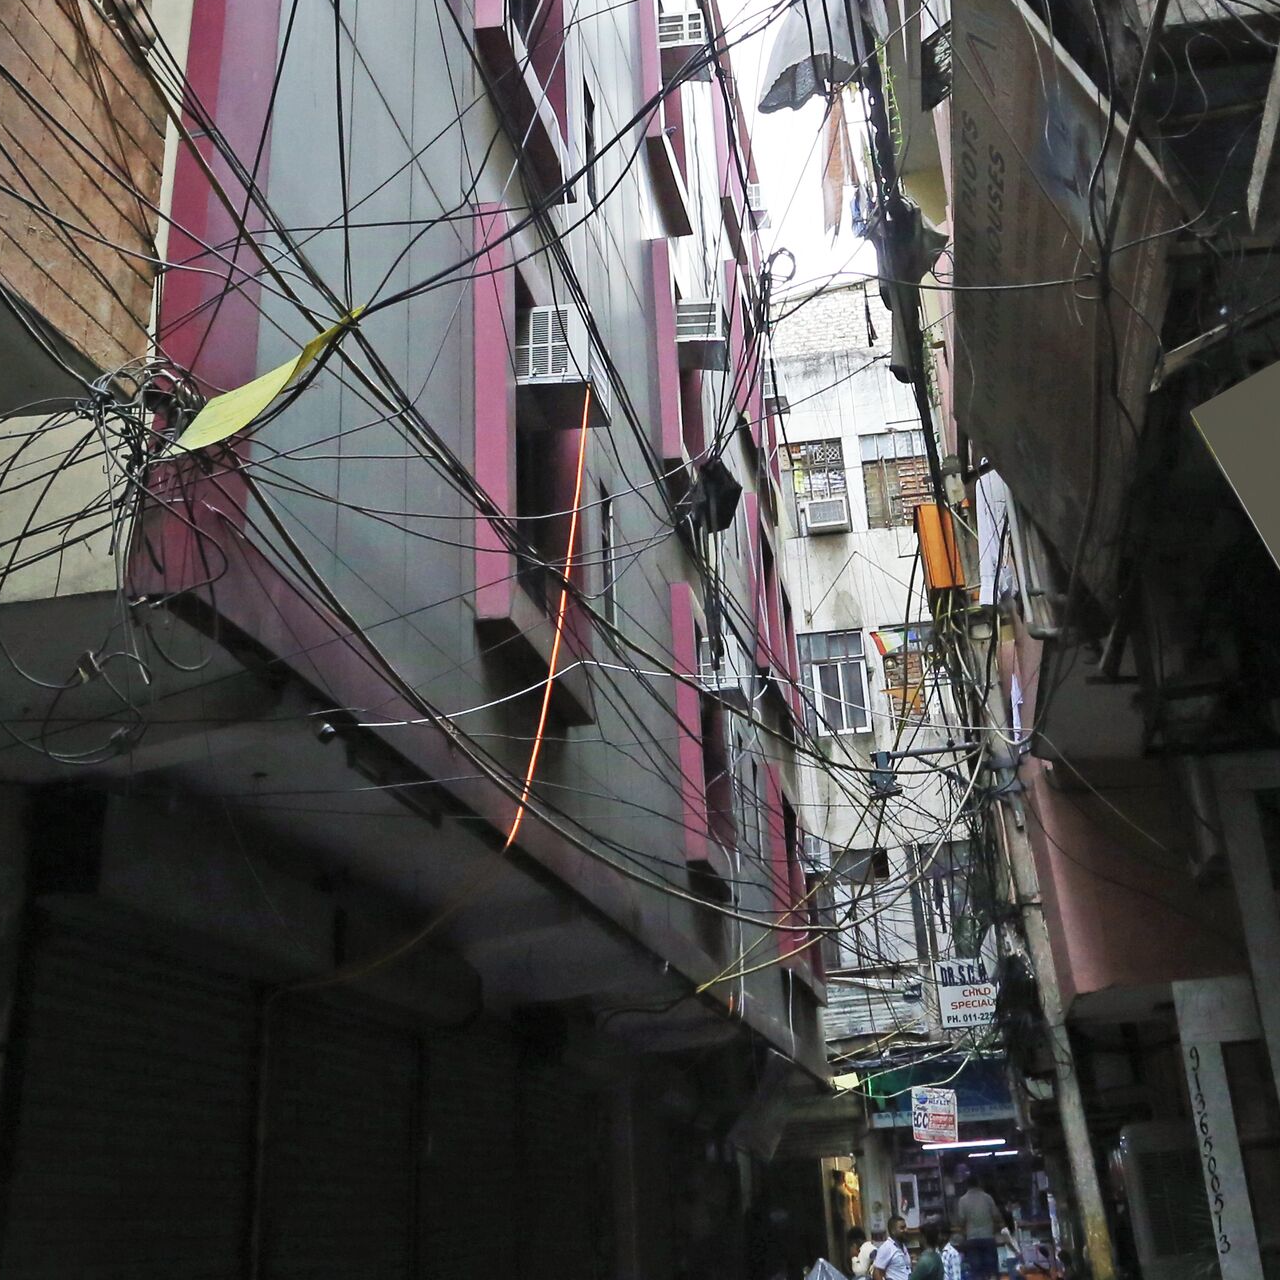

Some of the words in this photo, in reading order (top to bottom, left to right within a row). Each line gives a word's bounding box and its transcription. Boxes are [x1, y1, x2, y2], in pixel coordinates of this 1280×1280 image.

[961, 110, 978, 218] PLOTS
[986, 144, 1006, 276] HOUSES
[947, 1015, 961, 1024] PH.
[962, 986, 991, 998] CHILD
